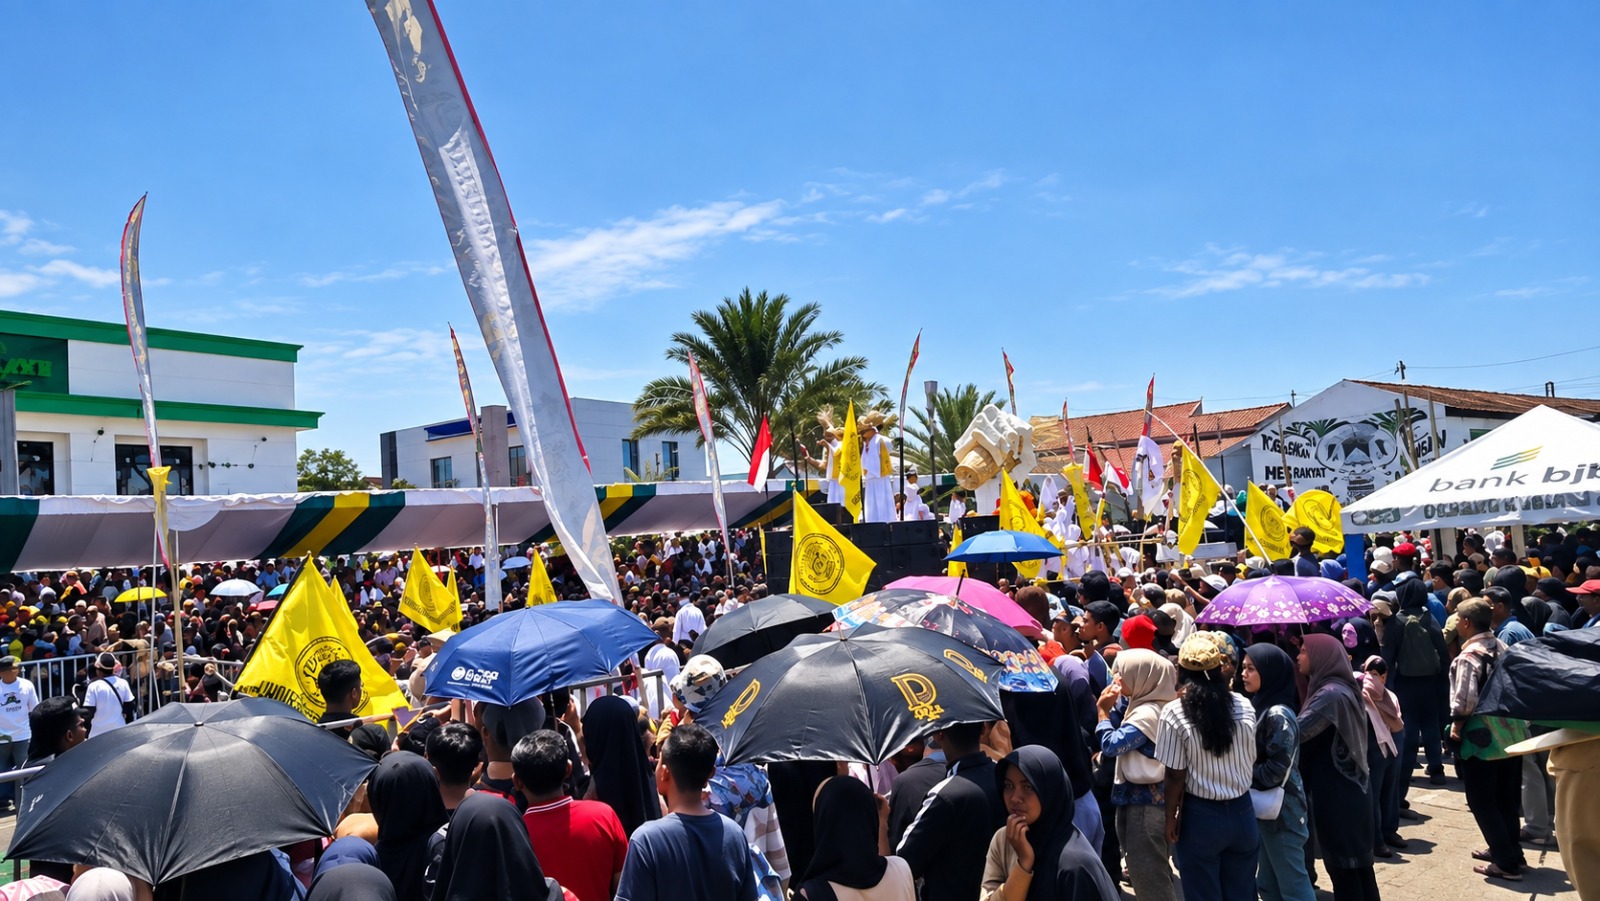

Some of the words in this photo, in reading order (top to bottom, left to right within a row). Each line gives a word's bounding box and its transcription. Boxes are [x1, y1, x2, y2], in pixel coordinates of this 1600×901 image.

[1293, 467, 1326, 478] RAKYAT
[1429, 471, 1528, 492] bank
[1542, 463, 1600, 485] bjb
